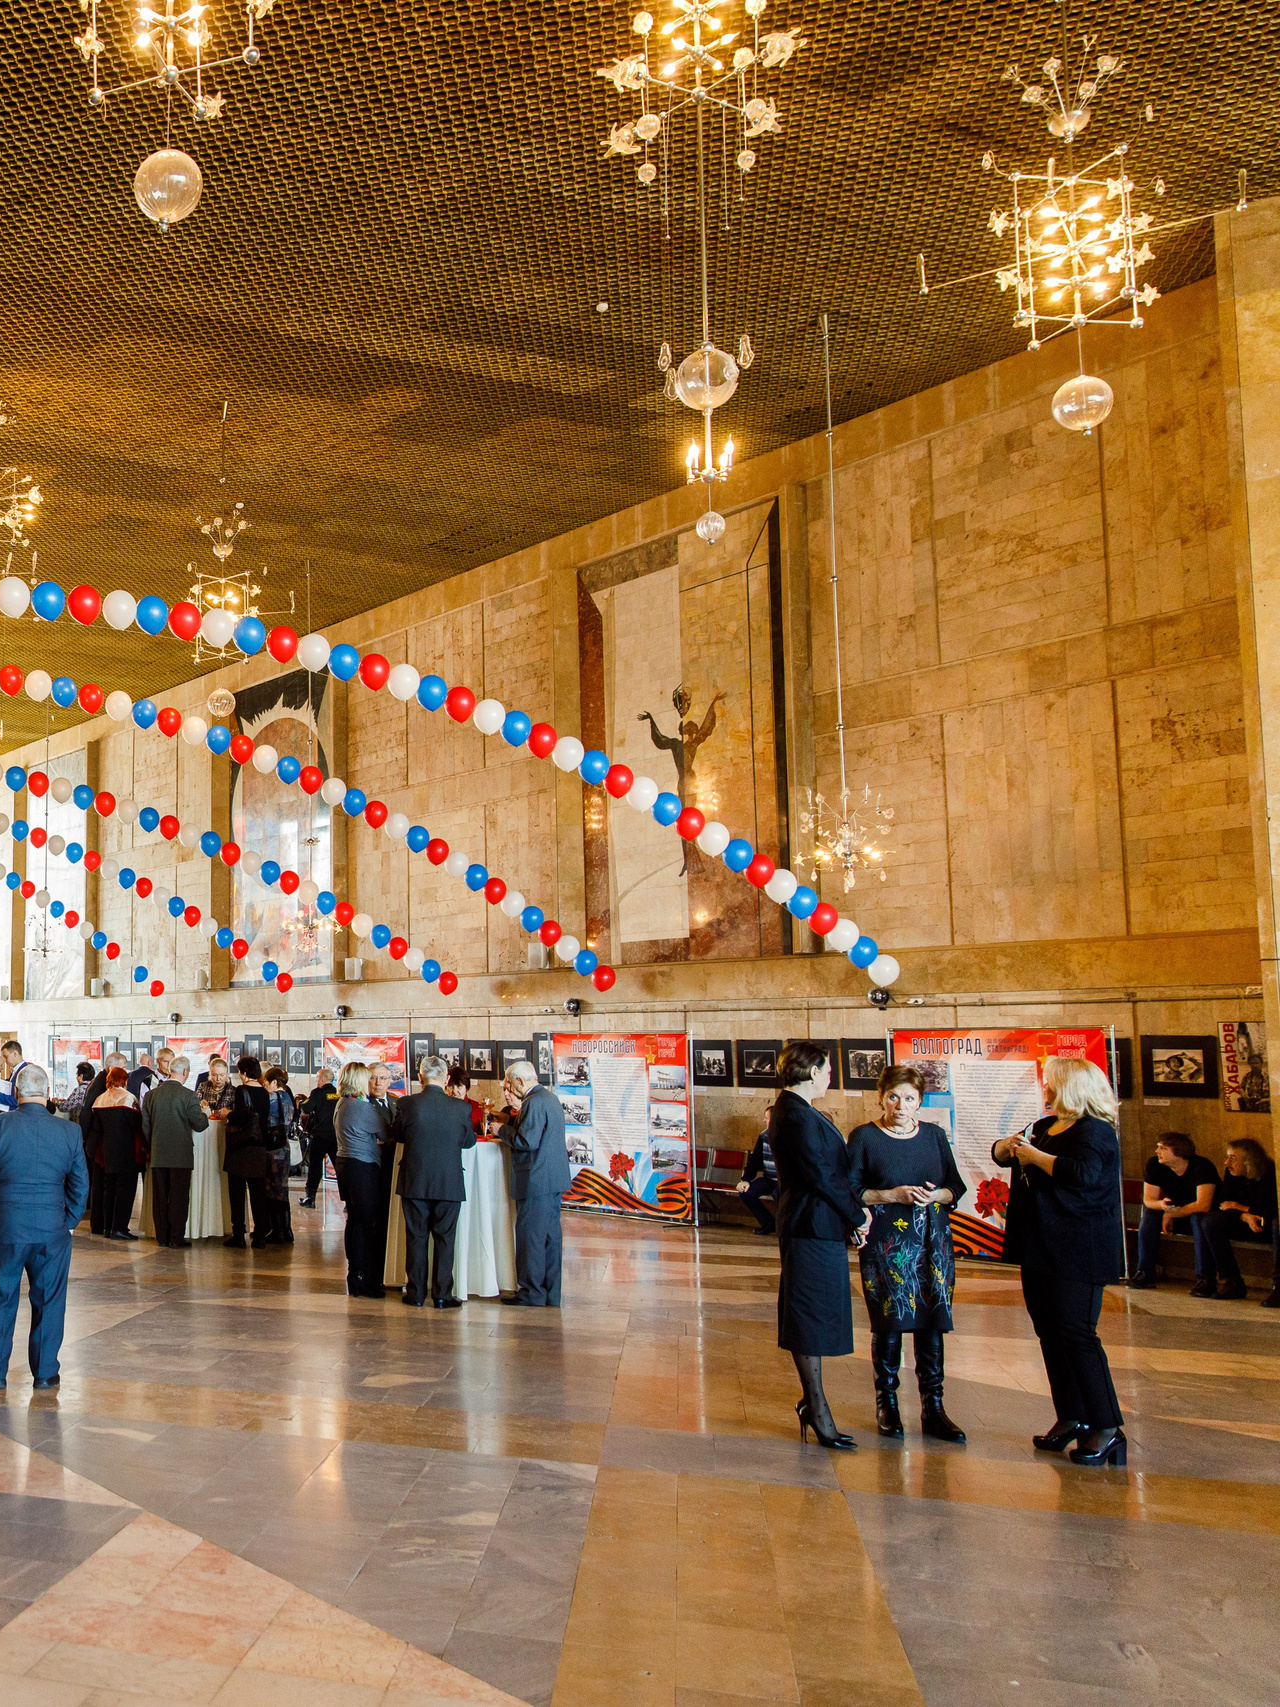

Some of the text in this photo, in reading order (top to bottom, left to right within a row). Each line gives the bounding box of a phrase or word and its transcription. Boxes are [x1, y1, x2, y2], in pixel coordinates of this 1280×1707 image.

[571, 1037, 676, 1054] НОВОРОССИЙСК ГОРОД
[912, 1038, 982, 1056] ВОЛГОГРАД
[1057, 1034, 1087, 1047] ГОРОД
[657, 1047, 676, 1058] ГЕРОЙ
[1222, 1023, 1241, 1096] ХАБАРОВ
